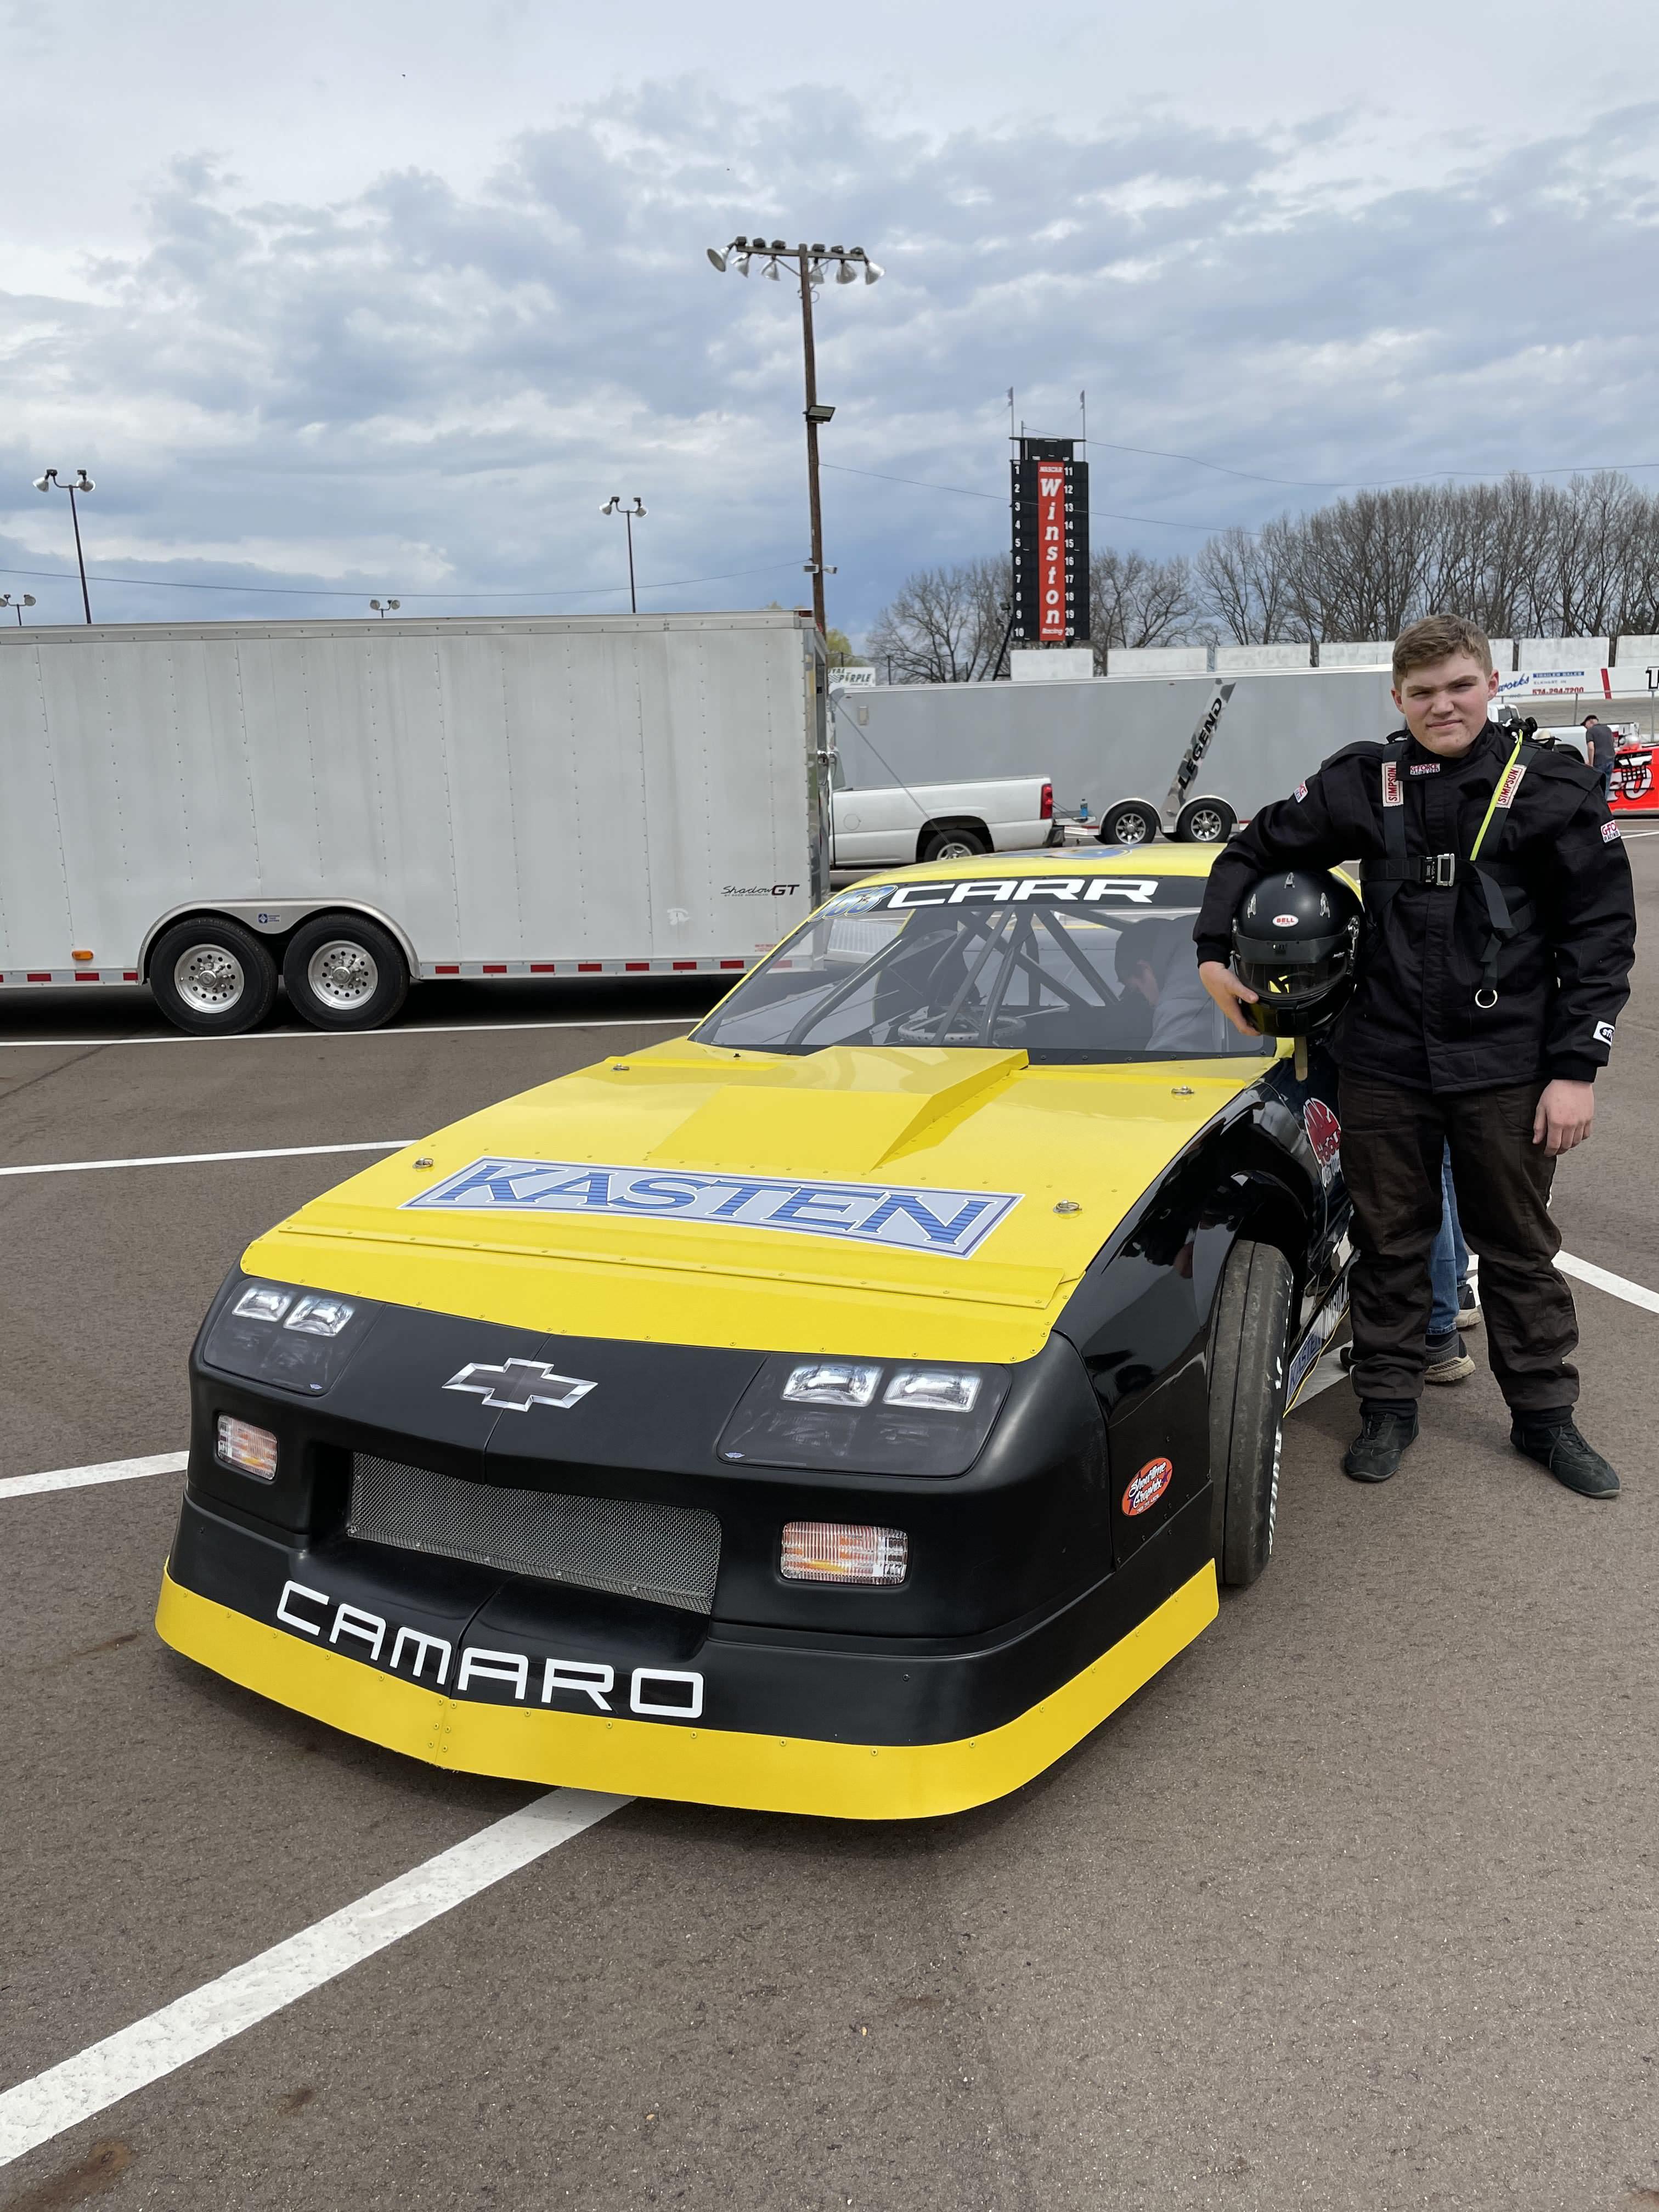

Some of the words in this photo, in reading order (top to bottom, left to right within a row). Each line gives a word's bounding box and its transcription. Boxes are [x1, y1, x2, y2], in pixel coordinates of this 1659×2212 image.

[1015, 466, 1020, 475] 1
[1064, 467, 1073, 476] 11
[1014, 484, 1020, 493] 2
[1064, 484, 1073, 494] 12
[1015, 502, 1020, 511] 3
[1064, 503, 1074, 512] 13
[1015, 520, 1020, 529] 4
[1064, 521, 1074, 530] 14
[1015, 538, 1021, 548] 5
[1064, 539, 1074, 548] 15
[1040, 478, 1063, 624] Winston
[1015, 556, 1021, 566] 6
[1065, 556, 1074, 566] 16
[1015, 574, 1021, 583] 7
[1065, 574, 1074, 583] 17
[1016, 592, 1022, 601] 8
[1065, 592, 1074, 601] 18
[1016, 610, 1022, 619] 9
[1065, 610, 1074, 619] 19
[1014, 628, 1024, 636] 10
[1065, 627, 1074, 636] 20
[1178, 698, 1222, 790] LEGEND
[1387, 768, 1397, 802] SIMPSON
[1498, 769, 1519, 803] SIMPSON
[1602, 822, 1617, 835] G-FO
[720, 886, 772, 895] Shadow
[771, 884, 800, 896] GT
[887, 878, 1158, 909] CARR
[431, 1164, 996, 1246] KASTEN
[1128, 1462, 1166, 1498] Showtime
[1133, 1478, 1163, 1509] Graphix
[276, 1579, 705, 1718] CAMARO
